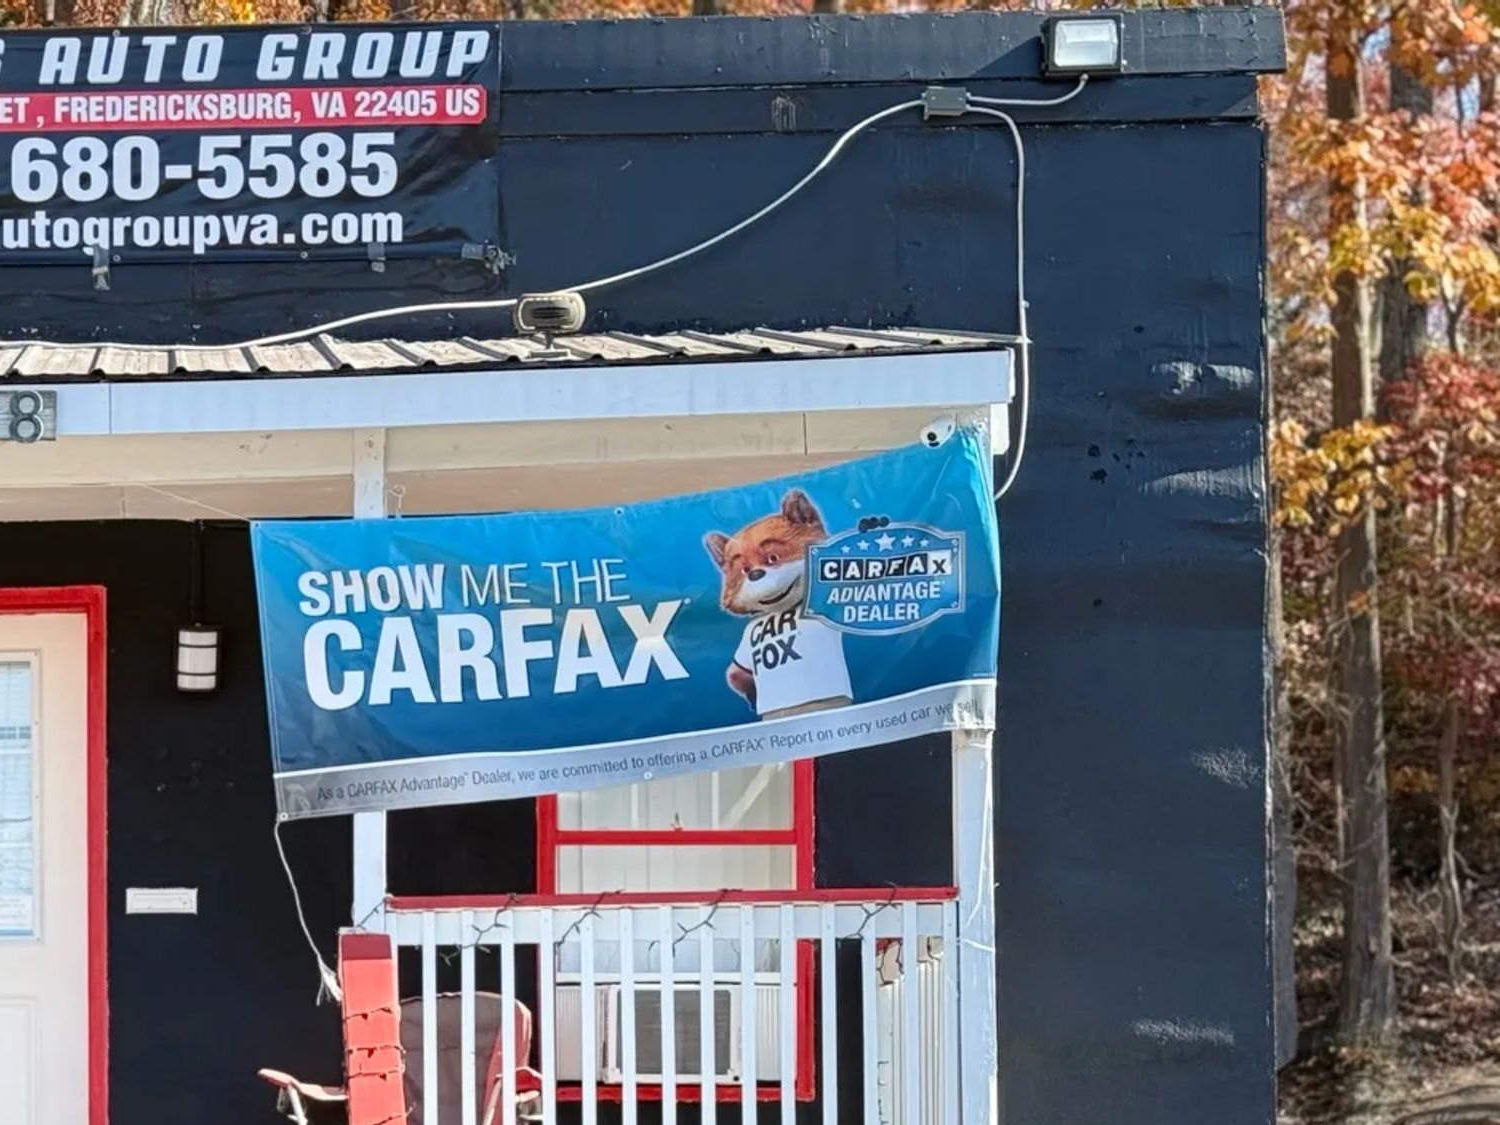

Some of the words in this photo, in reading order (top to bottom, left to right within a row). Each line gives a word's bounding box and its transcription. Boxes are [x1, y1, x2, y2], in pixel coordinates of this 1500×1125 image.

[38, 34, 224, 85] AUTO
[256, 30, 491, 80] GROUP
[54, 92, 302, 124] FREDERICKSBURG,
[311, 91, 347, 119] VA
[354, 89, 438, 118] 22405
[444, 87, 481, 116] US
[10, 131, 399, 204] 680-5585
[298, 563, 445, 618] SHOW
[460, 562, 533, 608] ME
[541, 557, 631, 606] THE
[823, 554, 951, 581] CARFAX
[827, 581, 942, 604] ADVANTAGE
[842, 602, 921, 624] DEALER
[751, 610, 797, 647] CAR
[303, 598, 691, 712] CARFAX
[752, 635, 803, 676] FOX
[317, 787, 333, 801] As
[336, 788, 345, 799] a
[347, 779, 398, 797] CARFAX
[472, 768, 515, 785] Dealer,
[518, 769, 536, 782] we
[539, 767, 560, 781] are
[562, 757, 628, 778] committed
[631, 755, 645, 769] to
[647, 751, 696, 768] offering
[699, 749, 708, 760] a
[770, 732, 814, 749] Report
[817, 730, 834, 742] on
[837, 720, 872, 737] every
[876, 712, 907, 729] used
[910, 706, 932, 722] car
[935, 703, 954, 716] we
